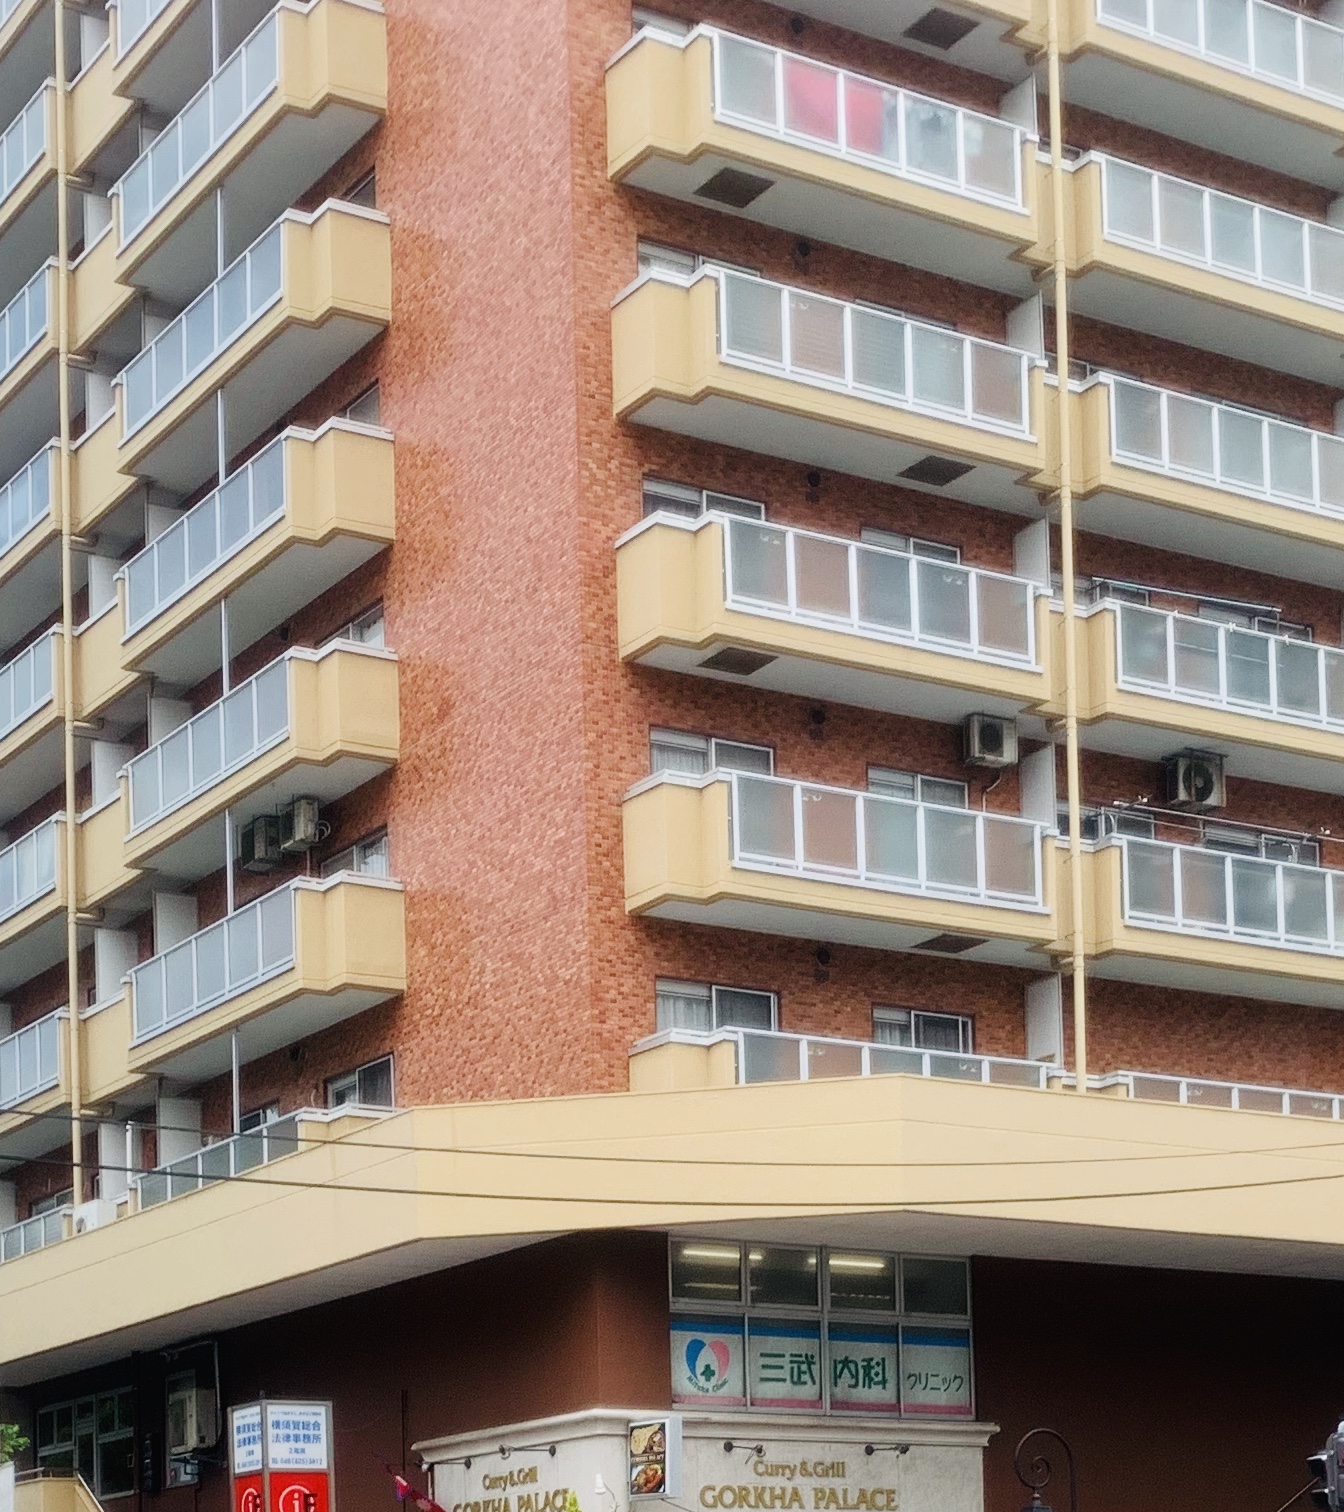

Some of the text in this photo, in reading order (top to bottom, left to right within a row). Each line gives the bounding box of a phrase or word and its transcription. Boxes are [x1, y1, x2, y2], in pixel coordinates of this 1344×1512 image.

[906, 1373, 964, 1393] クリニック
[754, 1459, 796, 1480] Curry
[813, 1461, 845, 1478] Grill
[482, 1473, 508, 1492] Curry
[700, 1484, 899, 1511] GORKHA PALACE
